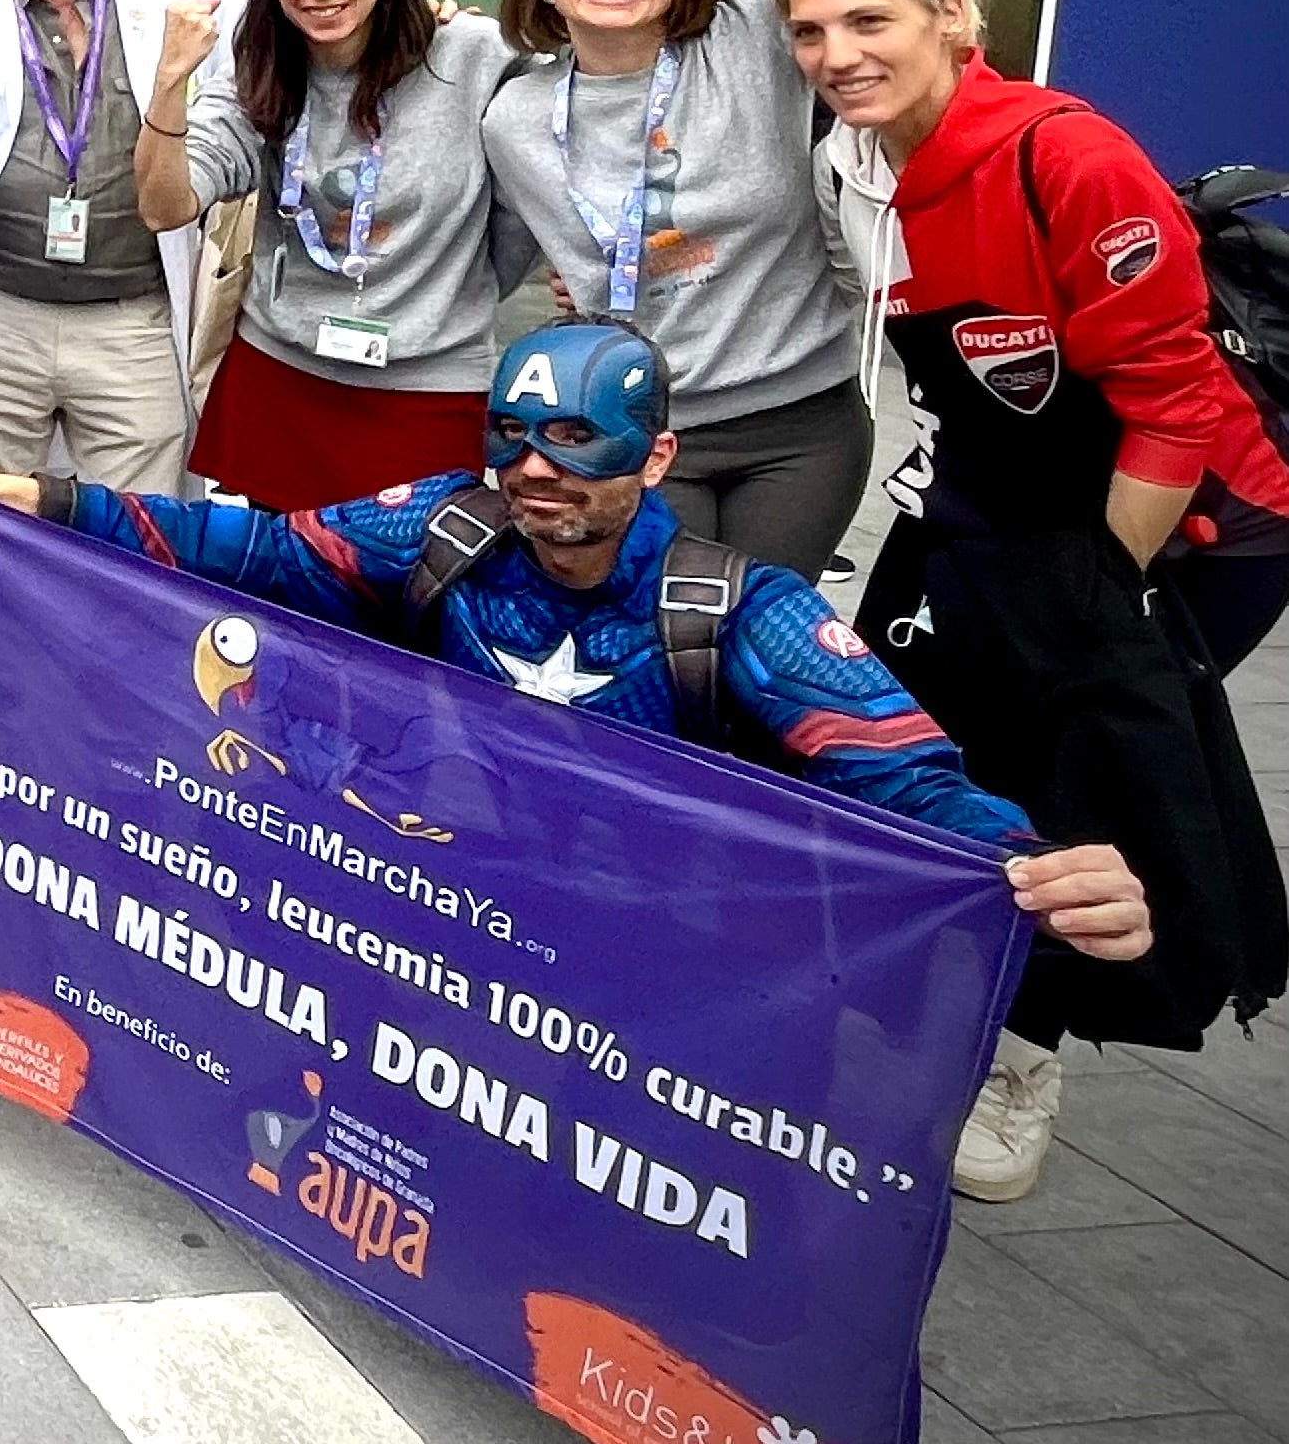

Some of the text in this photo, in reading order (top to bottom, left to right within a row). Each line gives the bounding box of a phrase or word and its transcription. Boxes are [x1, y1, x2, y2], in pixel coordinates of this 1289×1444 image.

[960, 325, 1047, 350] DUCATI
[989, 368, 1049, 389] CORSE
[63, 795, 111, 841] un
[119, 822, 252, 913] sueño,
[266, 879, 471, 1009] leucemia
[488, 980, 629, 1083] 100%
[54, 974, 232, 1086] En beneficio de:
[114, 895, 350, 1061] MÉDULA,
[372, 1022, 549, 1163] DONA
[574, 1120, 749, 1259] VIDA
[298, 1151, 431, 1279] aupa
